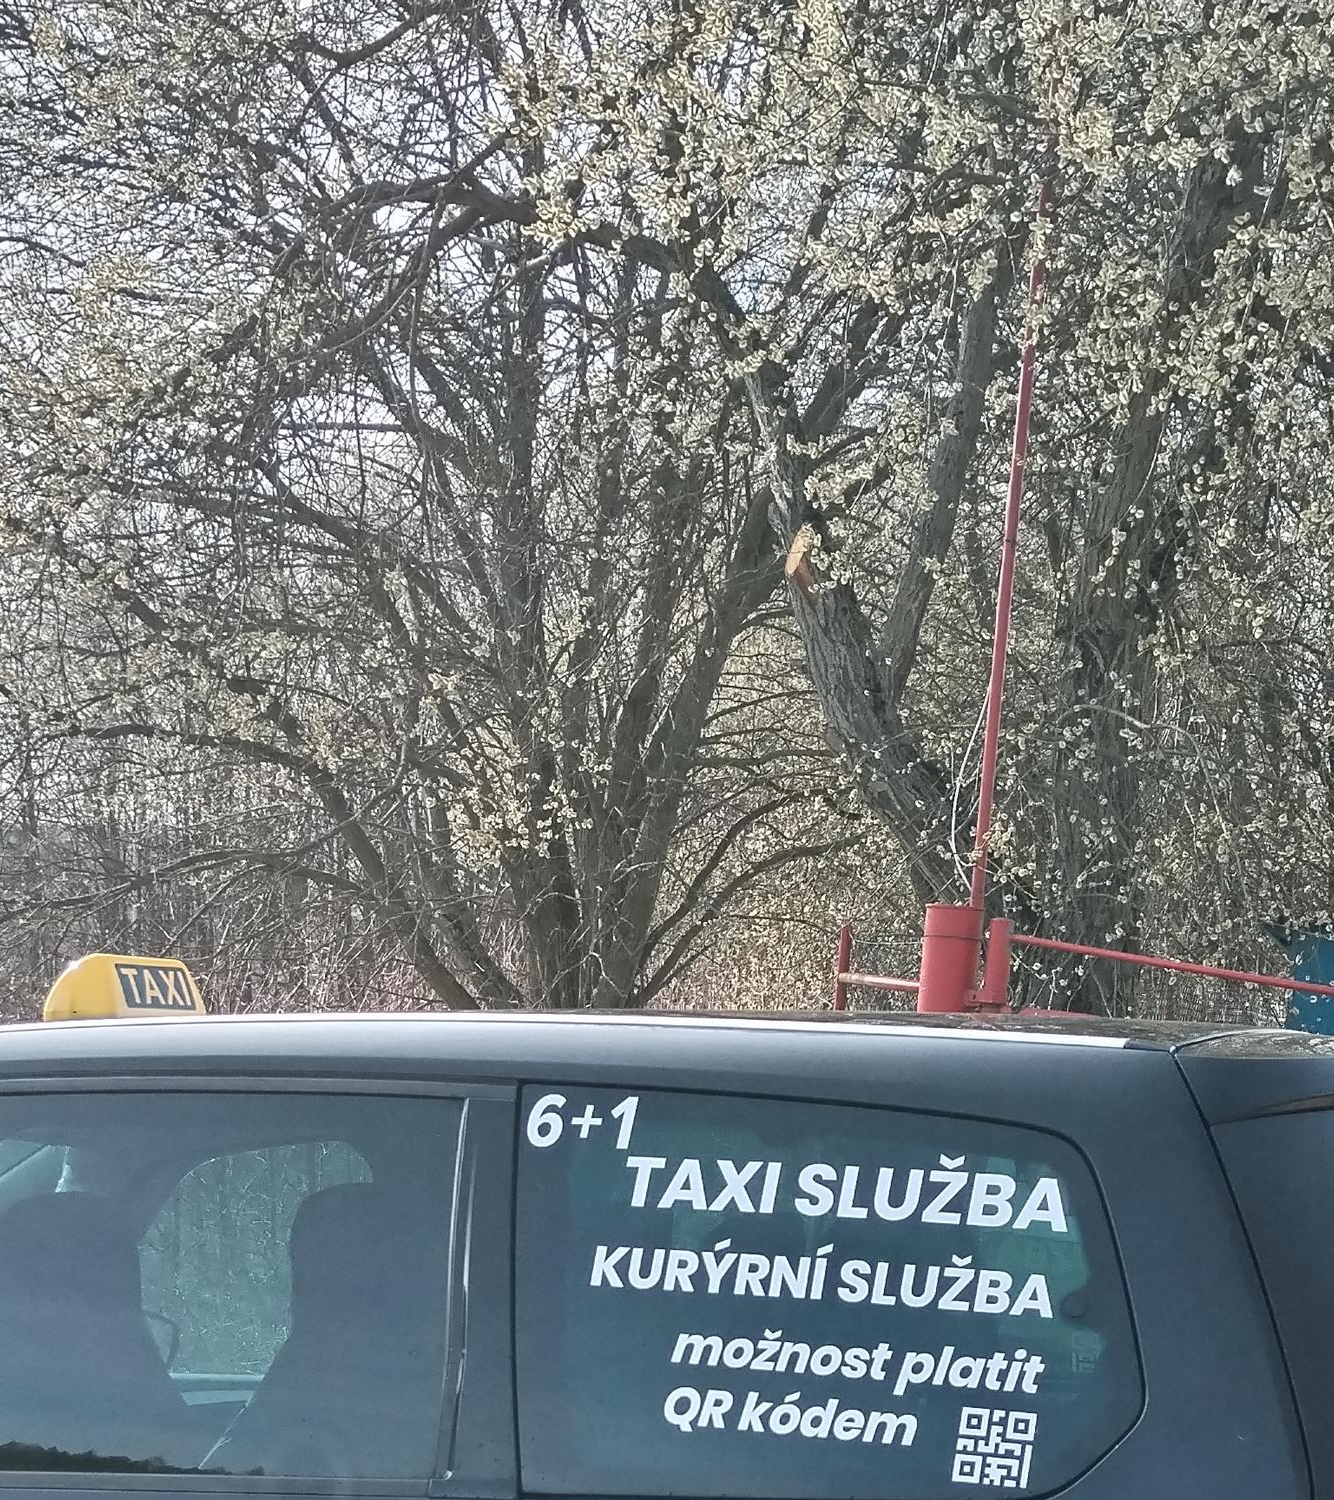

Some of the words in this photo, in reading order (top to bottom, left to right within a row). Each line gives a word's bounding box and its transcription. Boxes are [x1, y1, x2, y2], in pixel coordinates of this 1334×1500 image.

[120, 968, 191, 1006] TAXI
[526, 1093, 639, 1149] 6+1
[625, 1155, 782, 1214] TAXI
[795, 1153, 1069, 1233] SLUŽBA
[589, 1238, 834, 1300] KURÝRNÍ
[837, 1254, 1054, 1319] SLUŽBA
[670, 1328, 893, 1381] možnost
[892, 1342, 1045, 1396] platit
[663, 1386, 738, 1433] QR
[738, 1391, 919, 1447] kódem
